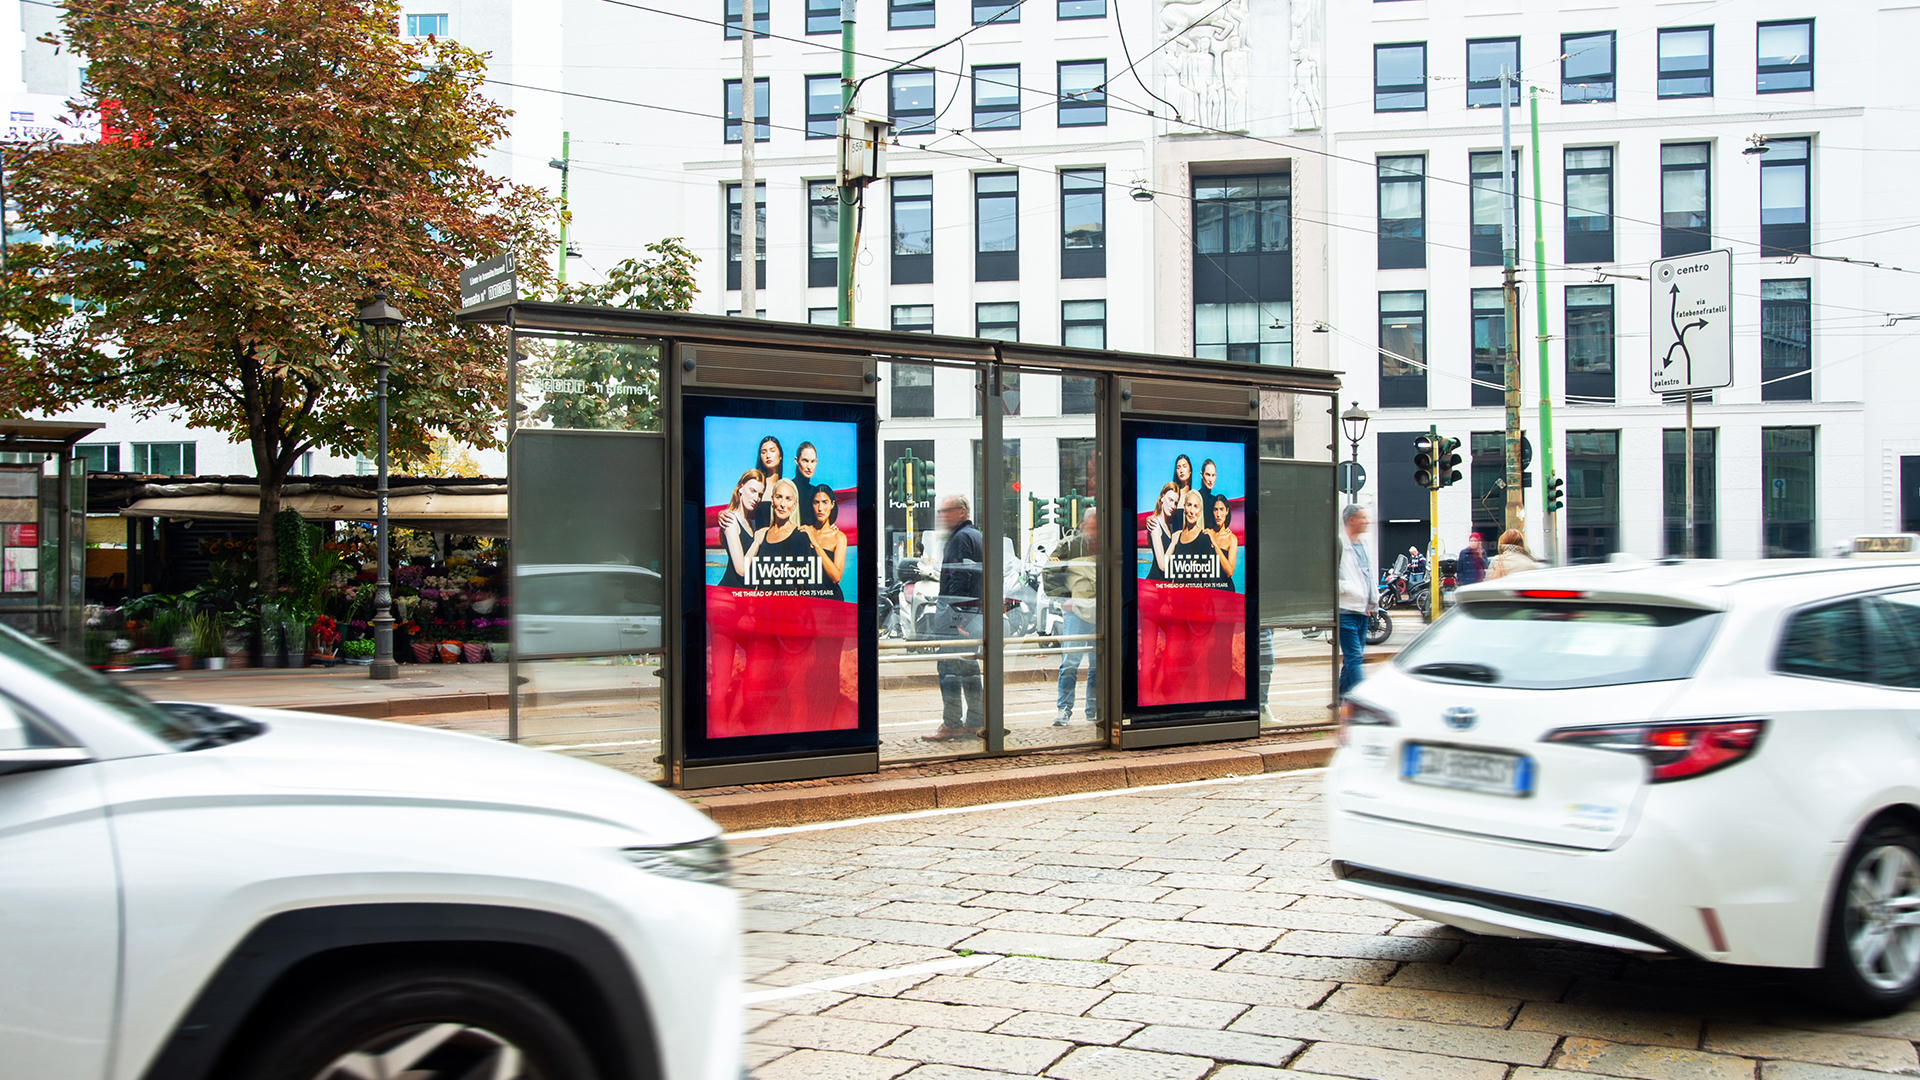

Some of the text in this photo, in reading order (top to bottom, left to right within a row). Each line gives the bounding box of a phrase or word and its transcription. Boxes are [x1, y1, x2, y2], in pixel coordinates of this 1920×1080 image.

[852, 141, 863, 153] 559
[1676, 263, 1710, 275] centro
[1696, 298, 1706, 306] via
[1676, 304, 1727, 318] fatebenefratelli
[1654, 369, 1663, 377] via
[1654, 379, 1680, 388] palestro
[382, 496, 388, 516] 32
[1856, 537, 1910, 552] TAXI
[757, 563, 810, 578] Wolford
[1174, 560, 1211, 573] Wolford
